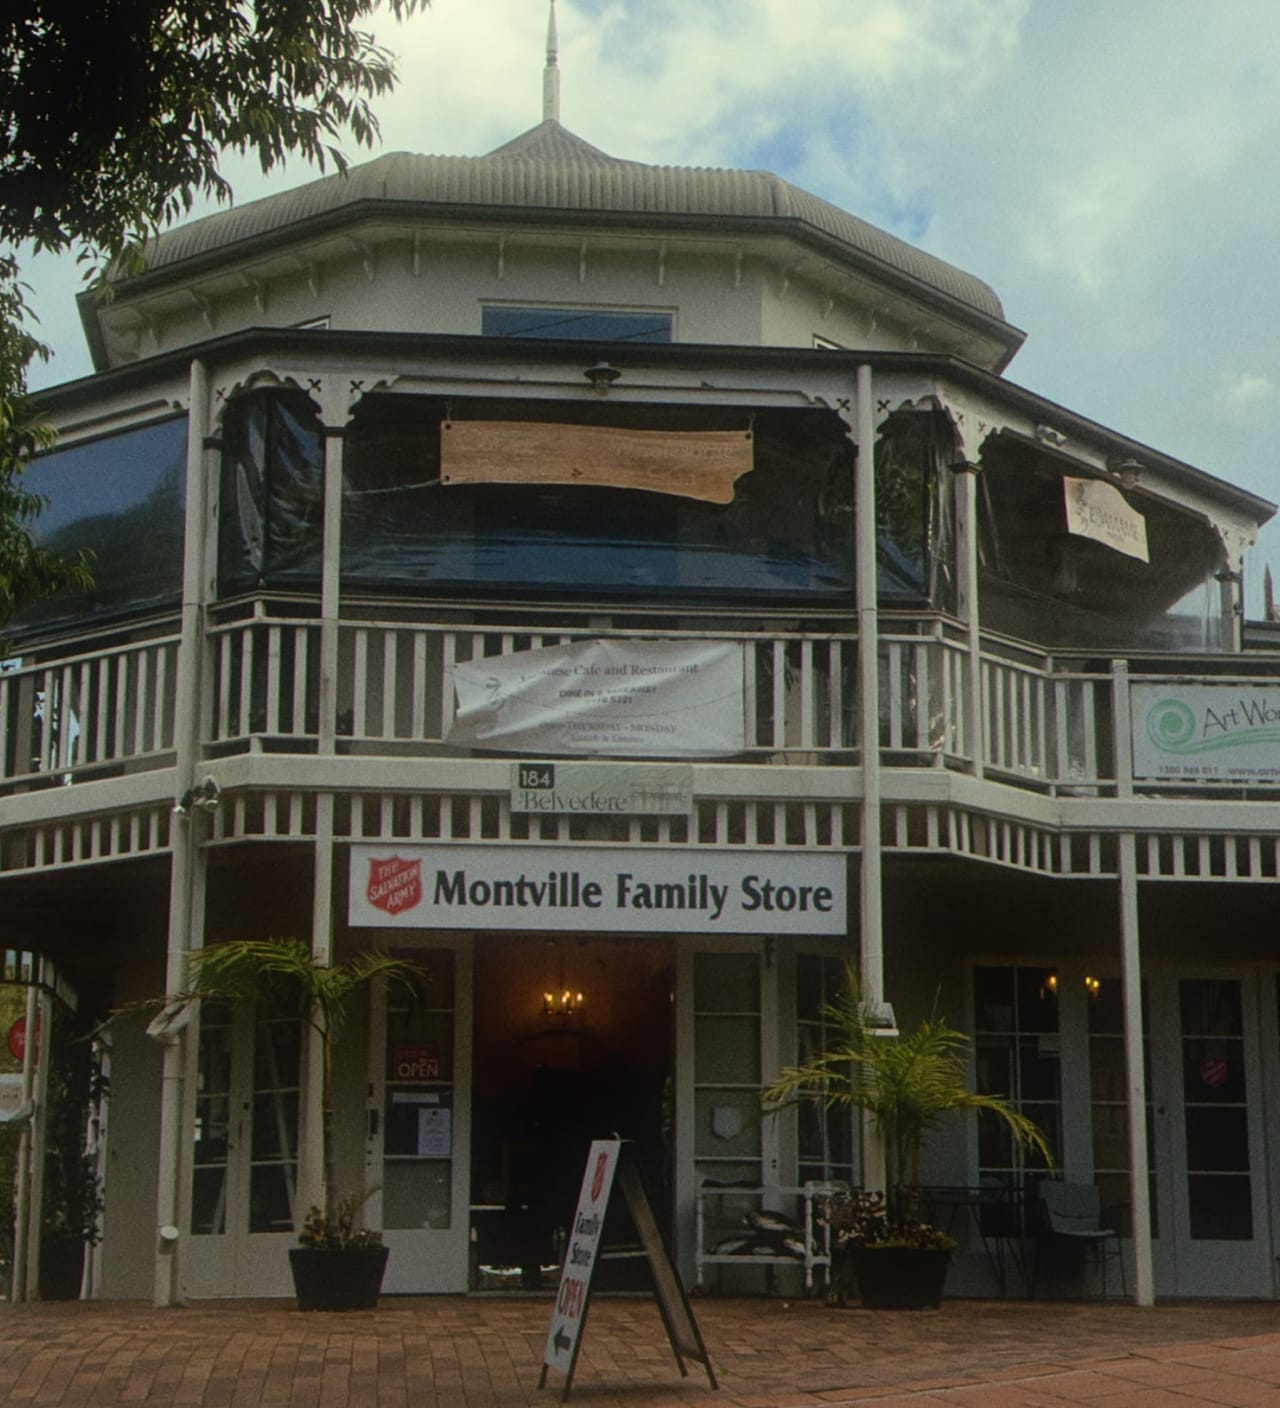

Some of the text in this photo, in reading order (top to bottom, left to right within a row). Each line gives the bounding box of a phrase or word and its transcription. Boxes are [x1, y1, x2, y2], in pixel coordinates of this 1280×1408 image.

[630, 722, 677, 733] MONDAY
[1202, 706, 1240, 737] Art
[521, 770, 550, 787] 184
[377, 862, 400, 877] THE
[370, 866, 421, 901] SALVATION
[433, 870, 833, 920] Montville Family Store
[386, 885, 416, 910] ARMY
[398, 1063, 439, 1077] OPEN
[574, 1211, 600, 1242] Family
[570, 1241, 592, 1267] Store
[558, 1277, 585, 1319] OPEN
